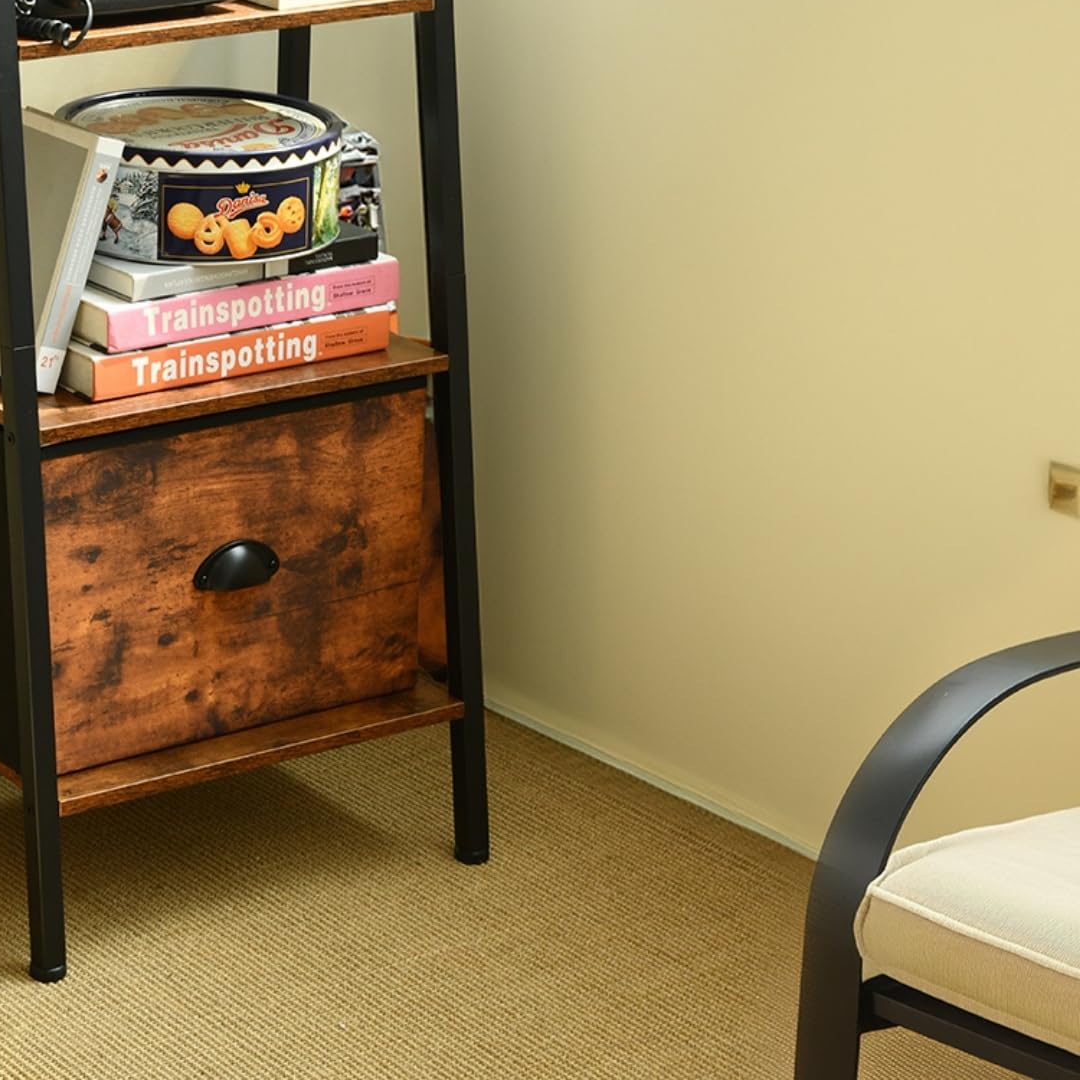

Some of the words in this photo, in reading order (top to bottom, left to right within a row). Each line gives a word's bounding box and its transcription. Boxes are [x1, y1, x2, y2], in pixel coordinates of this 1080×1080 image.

[171, 115, 295, 149] Danisa
[215, 190, 270, 219] Danisa
[143, 283, 326, 336] Trainspotting
[132, 332, 317, 386] Trainspotting
